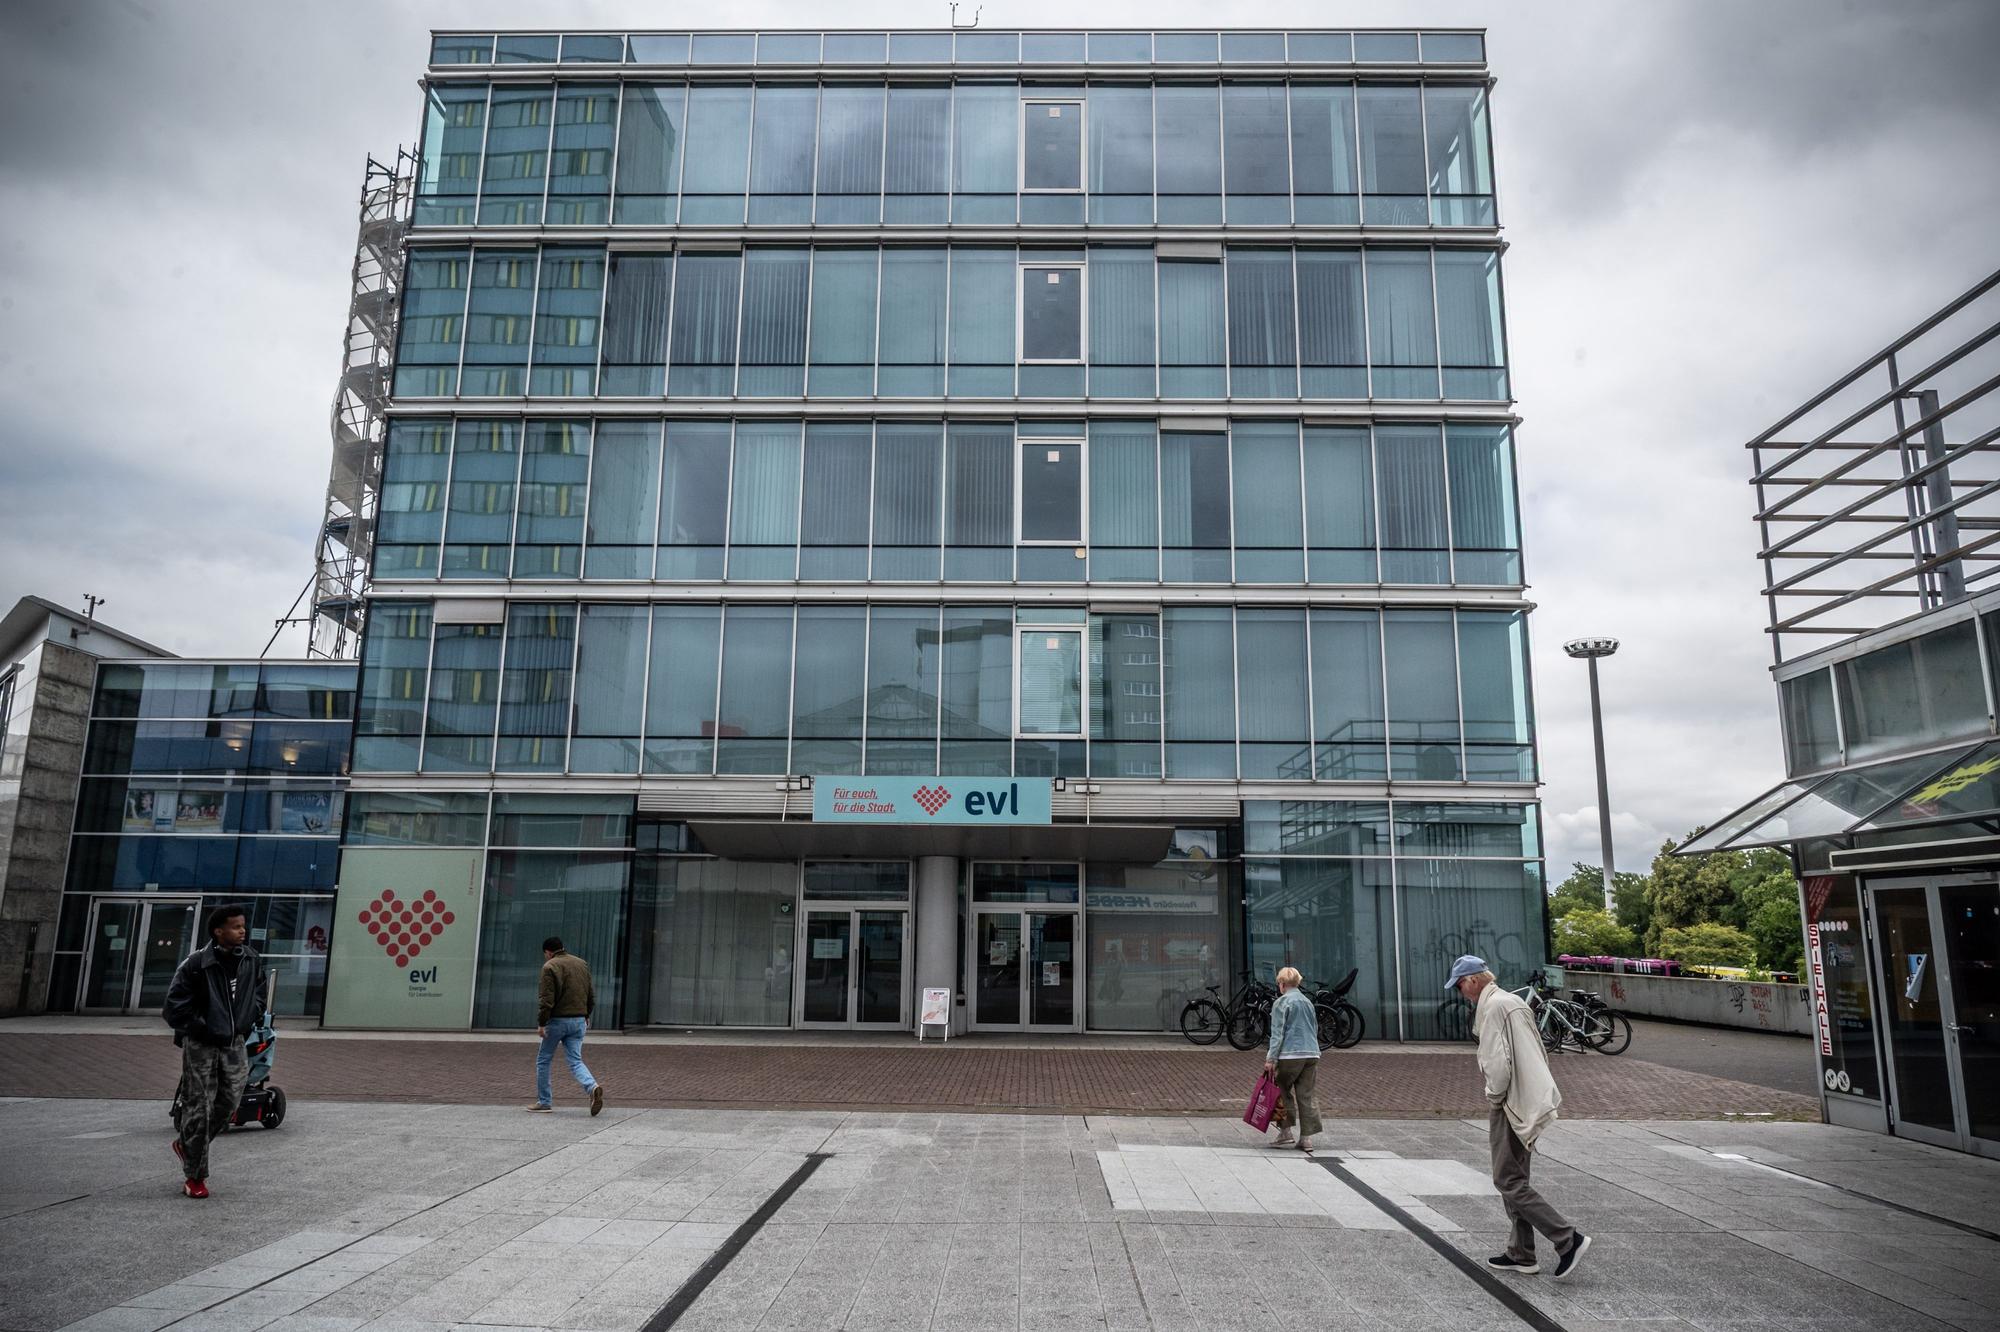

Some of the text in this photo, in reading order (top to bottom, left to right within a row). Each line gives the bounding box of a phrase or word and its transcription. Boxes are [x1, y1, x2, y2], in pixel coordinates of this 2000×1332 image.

[834, 788, 878, 799] Für euch,
[965, 783, 1019, 816] evl
[833, 802, 896, 813] für die Stadt.
[410, 966, 437, 983] evl
[1808, 925, 1831, 1055] SPIELHALLE
